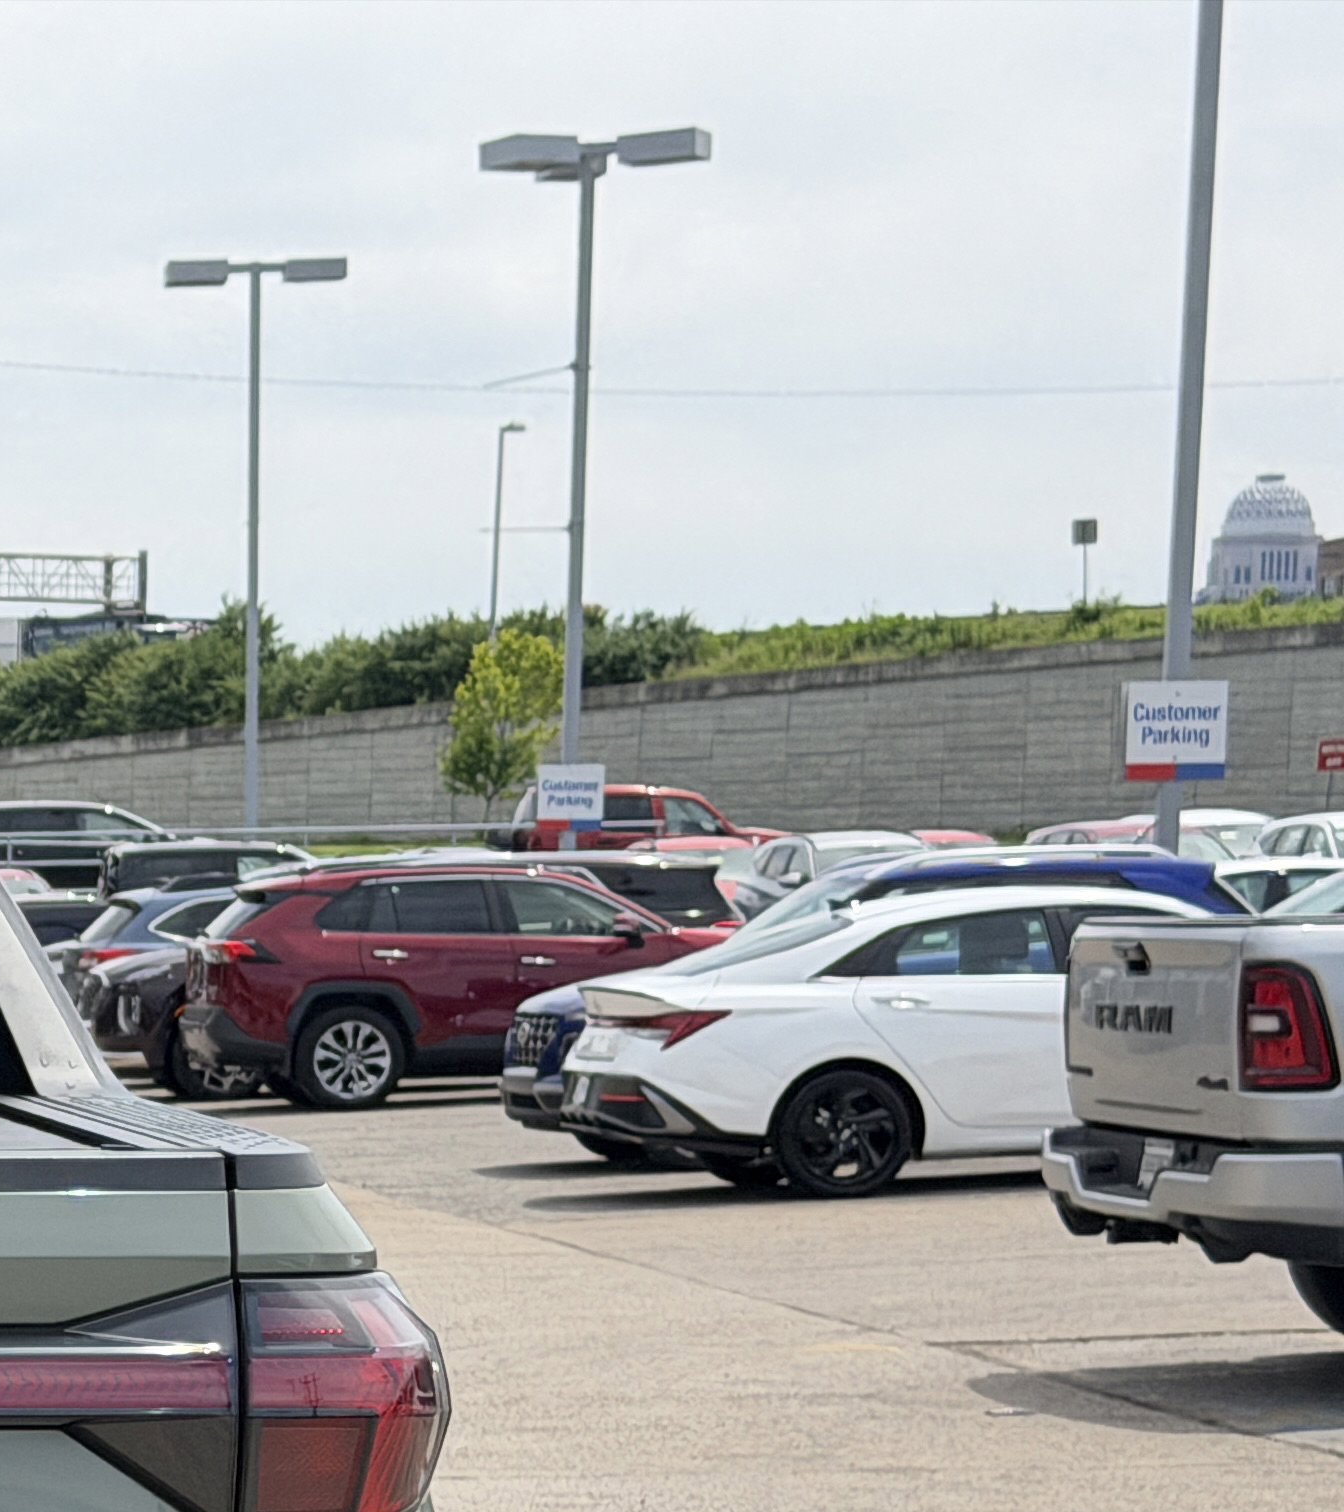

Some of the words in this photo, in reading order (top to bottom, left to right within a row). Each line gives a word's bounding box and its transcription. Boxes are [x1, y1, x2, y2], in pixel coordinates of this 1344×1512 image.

[1132, 702, 1221, 722] Customer
[1141, 726, 1211, 748] Parking
[1095, 1004, 1173, 1034] RAM
